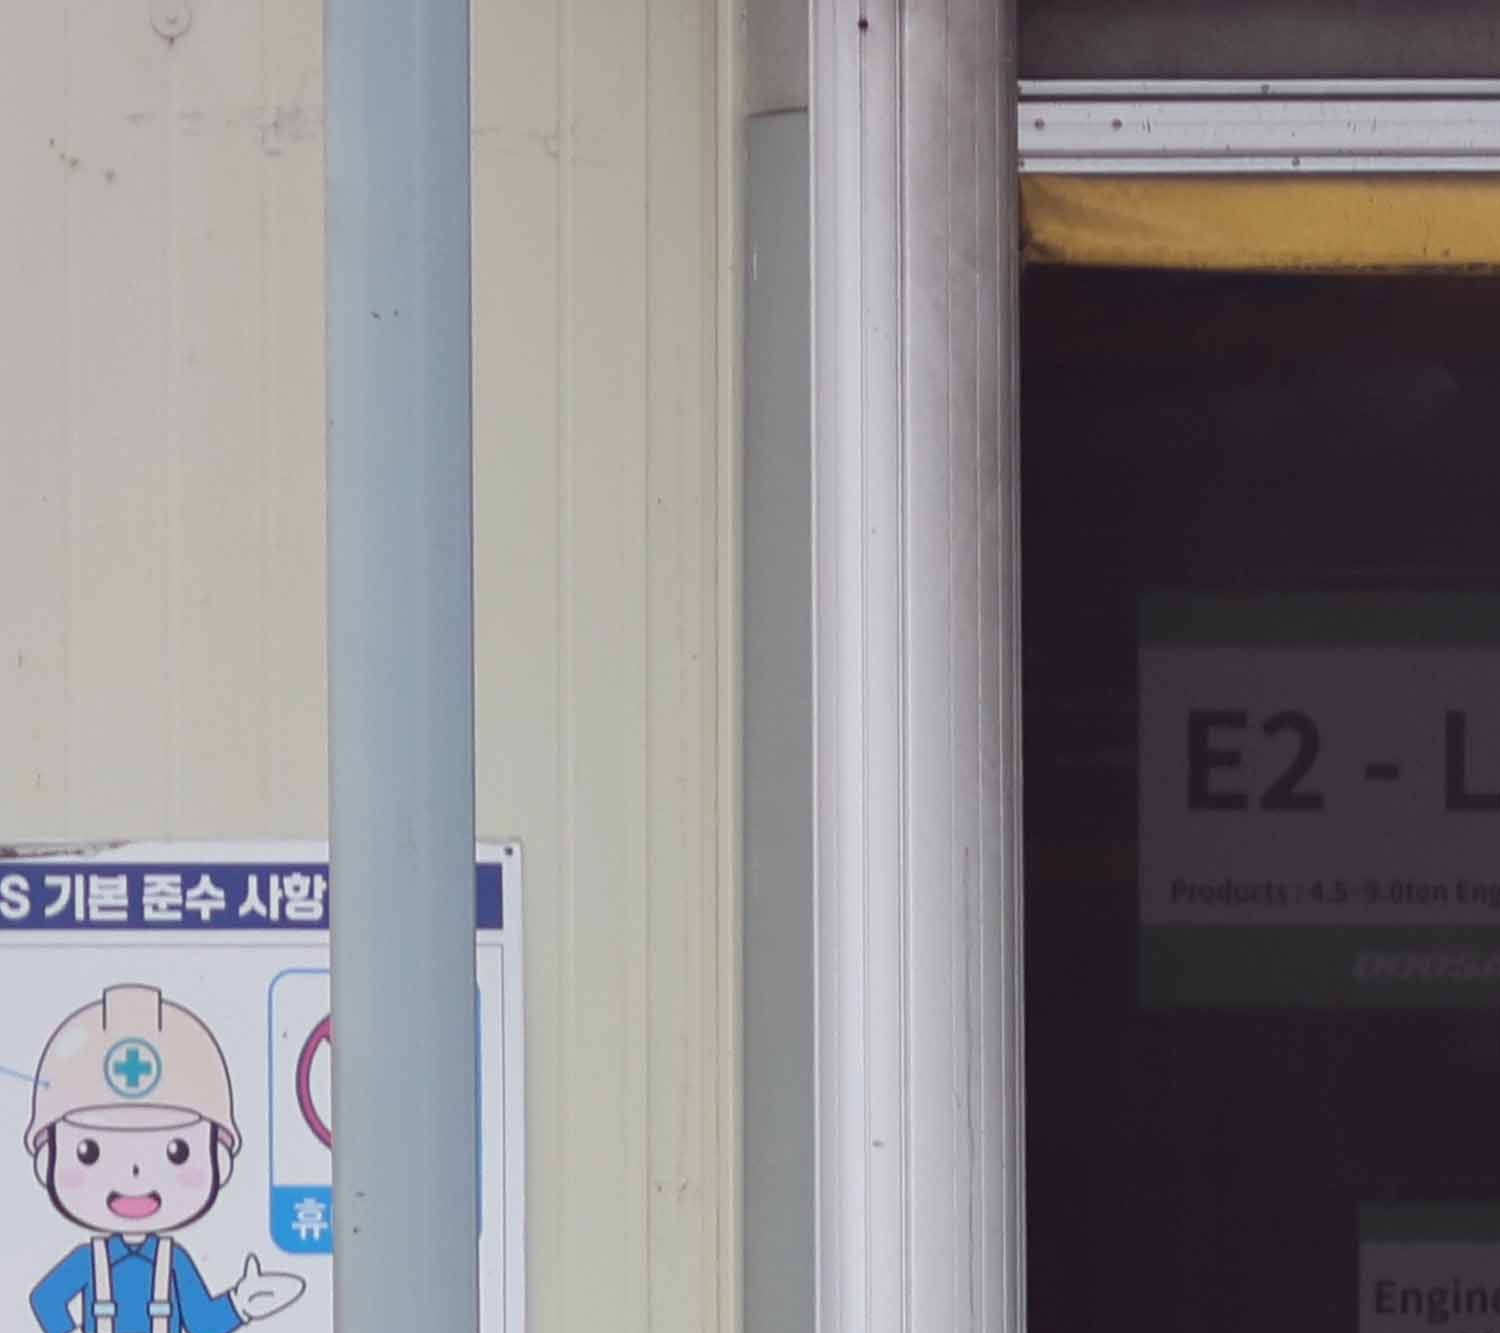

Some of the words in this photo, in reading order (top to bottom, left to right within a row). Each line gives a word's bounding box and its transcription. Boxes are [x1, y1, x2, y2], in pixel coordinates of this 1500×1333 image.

[1186, 709, 1325, 813] E2
[44, 873, 128, 922] 기본
[142, 873, 226, 922] 준수
[238, 871, 328, 922] 사항
[1170, 877, 1287, 905] Products
